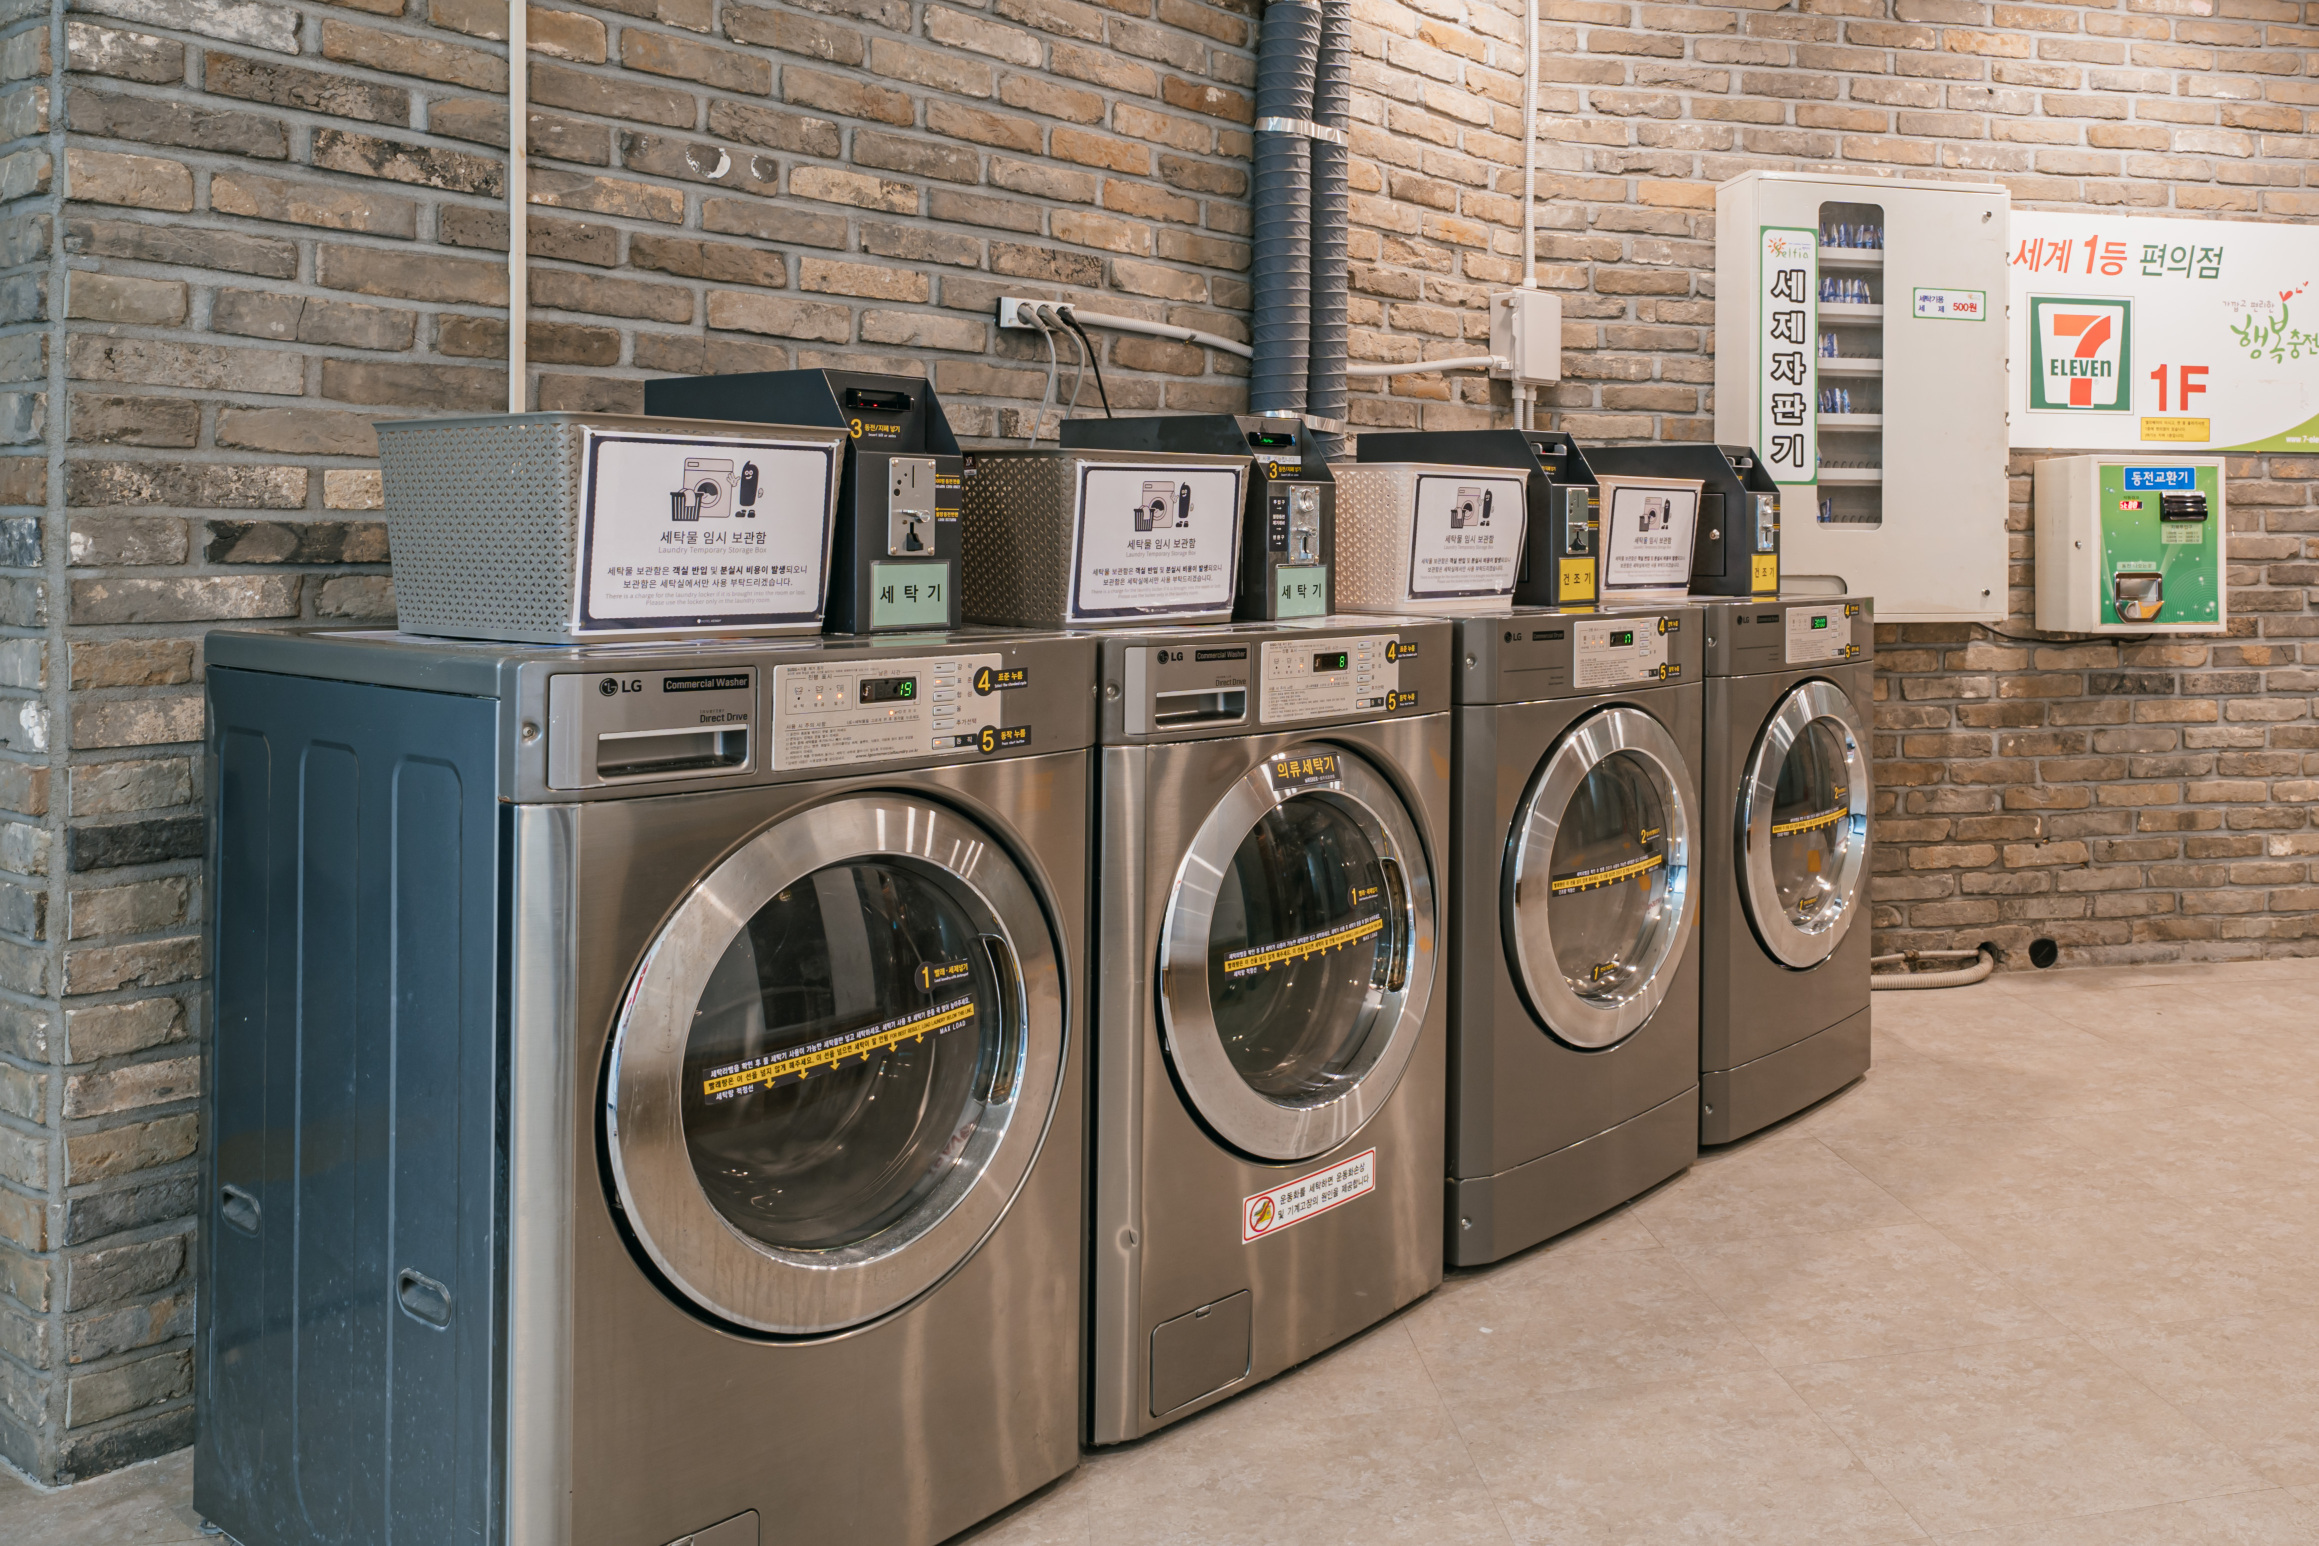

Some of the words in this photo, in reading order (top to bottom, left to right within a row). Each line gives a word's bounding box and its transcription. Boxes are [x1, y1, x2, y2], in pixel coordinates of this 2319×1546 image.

[2012, 237, 2073, 274] 세계
[2083, 234, 2128, 276] 1등
[2139, 243, 2224, 280] 편의점
[1919, 295, 1944, 303] 세탁기용
[1953, 302, 1977, 313] 500원
[2222, 300, 2246, 313] 가깝고
[2250, 300, 2275, 313] 편리한
[2053, 313, 2111, 406] 7
[1770, 268, 1806, 468] 세제자판기
[2150, 363, 2209, 411] 1F
[850, 418, 862, 439] 3
[1269, 462, 1278, 478] 3
[2131, 471, 2188, 486] 동전교환기
[660, 530, 698, 544] 세탁물
[703, 531, 727, 544] 임시
[731, 531, 767, 544] 보관함
[1127, 539, 1151, 550] 세탁물
[1155, 538, 1171, 549] 임시
[1173, 538, 1196, 549] 보관함
[728, 546, 753, 554] Storage
[1146, 550, 1170, 558] Temporary
[607, 566, 633, 576] 세탁물
[636, 566, 670, 576] 보관함은
[672, 565, 689, 575] 객실
[691, 565, 708, 575] 반입
[710, 566, 718, 575] 및
[720, 565, 743, 575] 분실시
[745, 565, 769, 575] 비용이
[771, 565, 808, 574] 발생되오니
[623, 579, 657, 589] 보관함은
[659, 579, 709, 588] 세탁실에서만
[712, 578, 727, 588] 사용
[730, 577, 793, 587] 부탁드리겠습니다.
[1845, 603, 1850, 617] 4
[1659, 619, 1665, 633] 4
[1512, 633, 1522, 641] LG
[1171, 651, 1183, 661] LG
[1196, 652, 1226, 660] Commercial
[1227, 651, 1246, 659] Washer
[1387, 643, 1396, 660] 4
[1845, 645, 1851, 659] 5
[1339, 655, 1345, 667] 8
[997, 672, 1010, 682] 표준
[1011, 670, 1024, 680] 누름
[1660, 665, 1666, 680] 5
[621, 680, 642, 693] LG
[665, 678, 715, 690] Commercial
[716, 678, 748, 688] Washer
[977, 669, 991, 691] 4
[1216, 679, 1232, 687] Direct
[1232, 678, 1246, 686] Drive
[900, 681, 913, 696] 19
[1388, 693, 1396, 710] 5
[700, 714, 725, 723] Direct
[726, 713, 748, 722] Drive
[1014, 728, 1026, 738] 누름
[982, 730, 994, 752] 5
[1277, 755, 1335, 779] 의류세탁기
[1641, 829, 1647, 844] 2
[1351, 888, 1357, 905] 1
[921, 966, 929, 988] 1
[1594, 966, 1599, 980] 1
[939, 1025, 951, 1035] MAX
[952, 1020, 966, 1030] LOAD
[710, 1064, 739, 1078] 세탁라벨을
[741, 1060, 753, 1070] 확인
[770, 1052, 787, 1063] 세탁기
[788, 1047, 805, 1058] 사용이
[806, 1042, 822, 1053] 가능한
[845, 1033, 856, 1043] 넣고
[882, 1020, 896, 1031] 세탁기
[897, 1017, 906, 1026] 사용
[736, 1075, 743, 1083] 이
[745, 1071, 758, 1081] 선을
[760, 1067, 772, 1077] 넘지
[774, 1065, 786, 1074] 않게
[715, 1089, 734, 1101] 세탁량
[736, 1084, 754, 1095] 적정선
[1280, 1186, 1306, 1206] 운동화를
[1309, 1175, 1334, 1193] 세탁하면
[1336, 1162, 1366, 1183] 운동화손상
[1277, 1209, 1285, 1220] 및
[1287, 1195, 1319, 1216] 기계고장의
[1321, 1186, 1339, 1203] 원인을
[1341, 1173, 1370, 1194] 제공합니다
